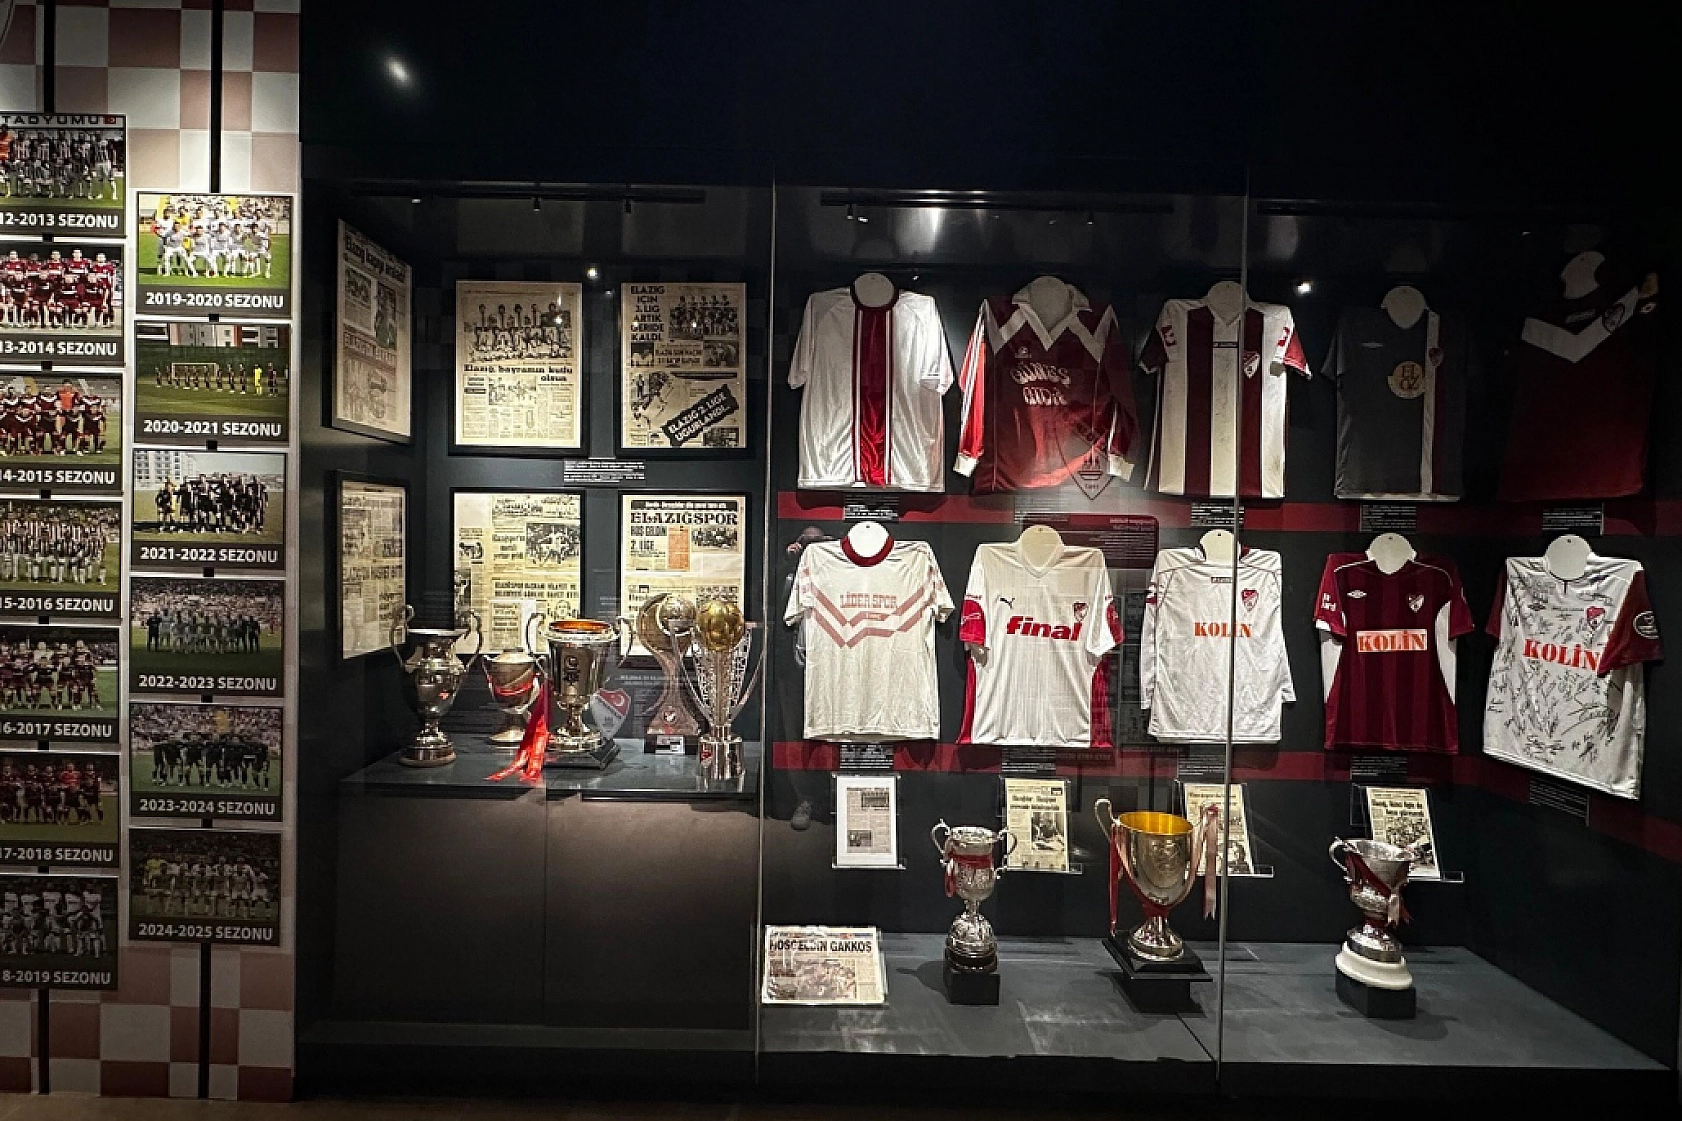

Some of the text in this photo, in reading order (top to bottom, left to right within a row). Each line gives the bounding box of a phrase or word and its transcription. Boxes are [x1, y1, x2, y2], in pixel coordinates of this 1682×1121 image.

[58, 213, 119, 228] SEZONU
[146, 291, 284, 308] 2019-2020 SEZONU
[57, 341, 117, 356] SEZONU
[143, 419, 281, 437] 2020-2021 SEZONU
[56, 470, 115, 485] SEZONU
[140, 546, 278, 563] 2021-2022 SEZONU
[55, 597, 114, 612] SEZONU
[1006, 615, 1083, 641] final
[1194, 621, 1252, 638] KOLN
[138, 674, 277, 691] 2022-2023 SEZONU
[54, 723, 112, 738] SEZONU
[139, 798, 276, 816] 2023-2024 SEZONU
[55, 847, 114, 862] SEZONU
[138, 923, 274, 941] 2024-2025 SEZONU
[2, 970, 111, 986] 8-2019 SEZONU
